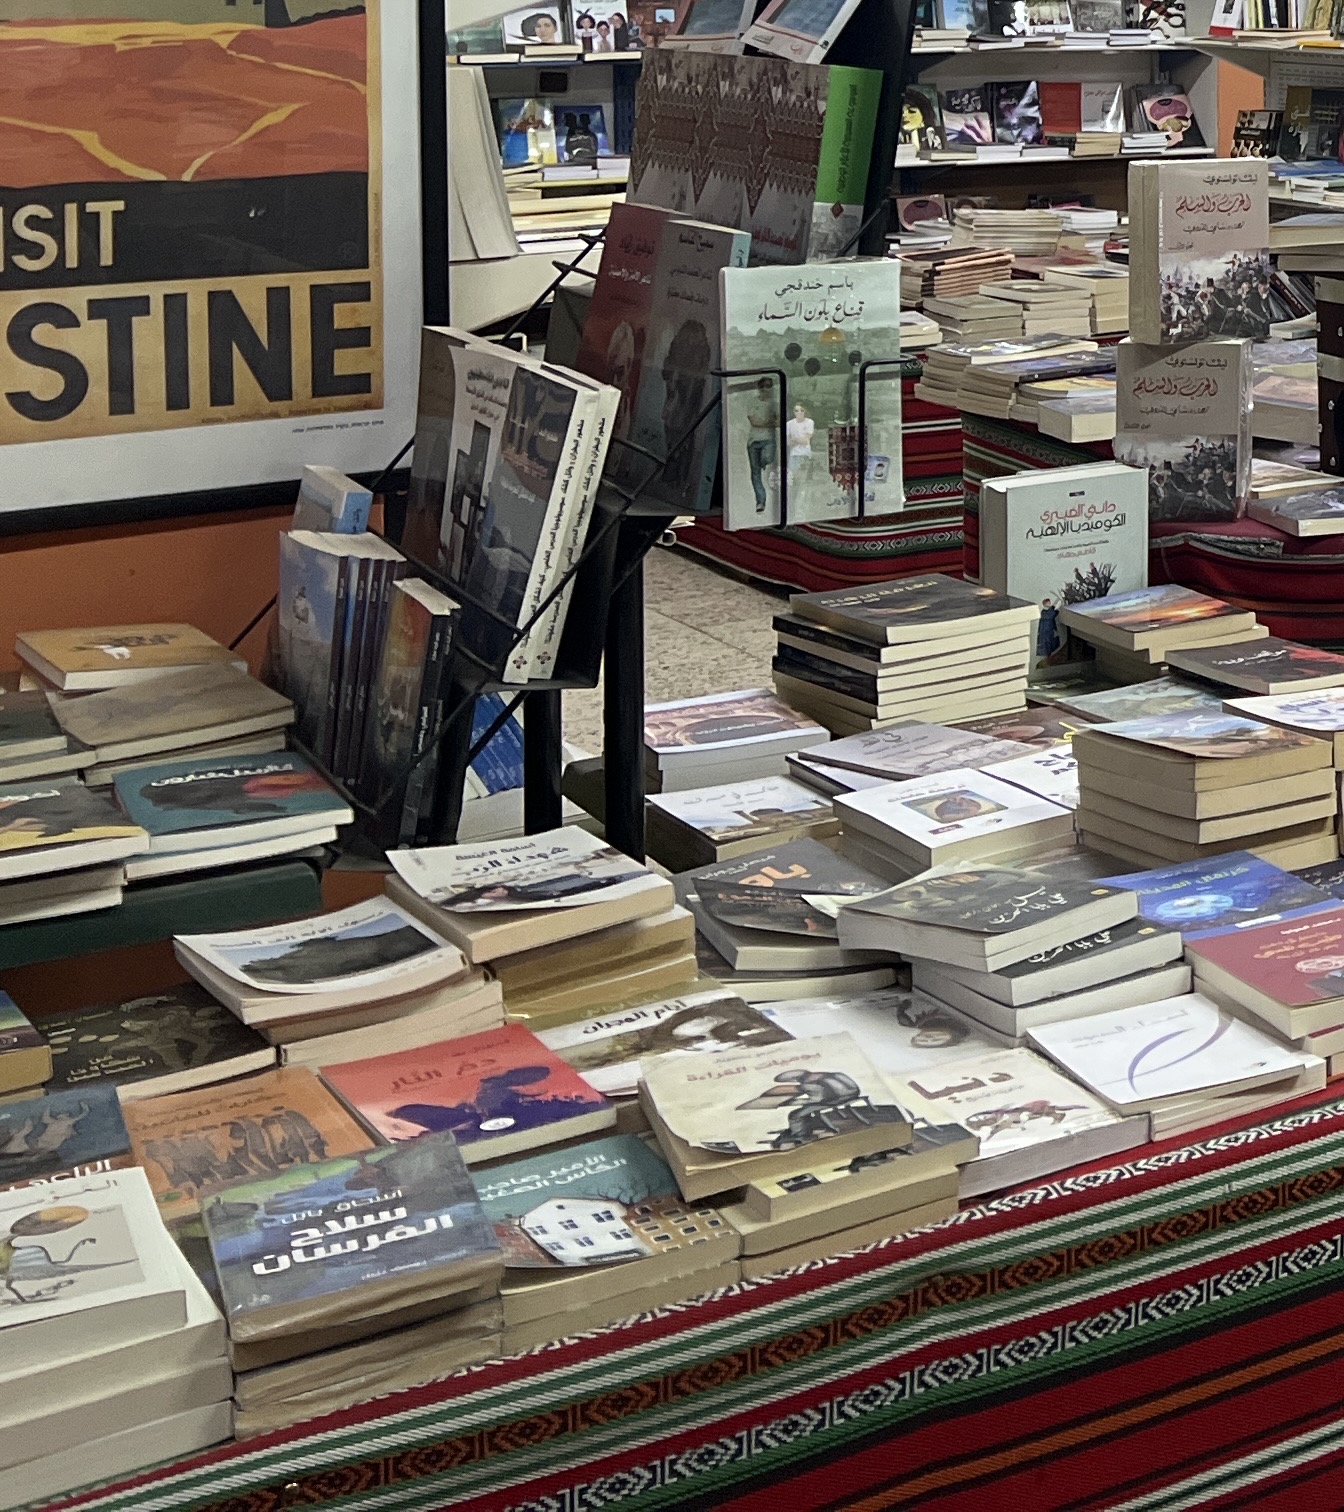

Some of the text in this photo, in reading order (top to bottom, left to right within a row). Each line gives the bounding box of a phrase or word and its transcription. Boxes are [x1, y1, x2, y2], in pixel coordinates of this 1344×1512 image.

[0, 199, 126, 273] SIT
[775, 275, 854, 299] باسم خندقجي
[803, 299, 830, 322] بلون
[832, 300, 865, 324] قناع
[1070, 513, 1126, 532] الكوميديا
[907, 1072, 1014, 1104] دنيا
[290, 1207, 408, 1248] سلاح
[252, 1214, 455, 1276] الفرسان
